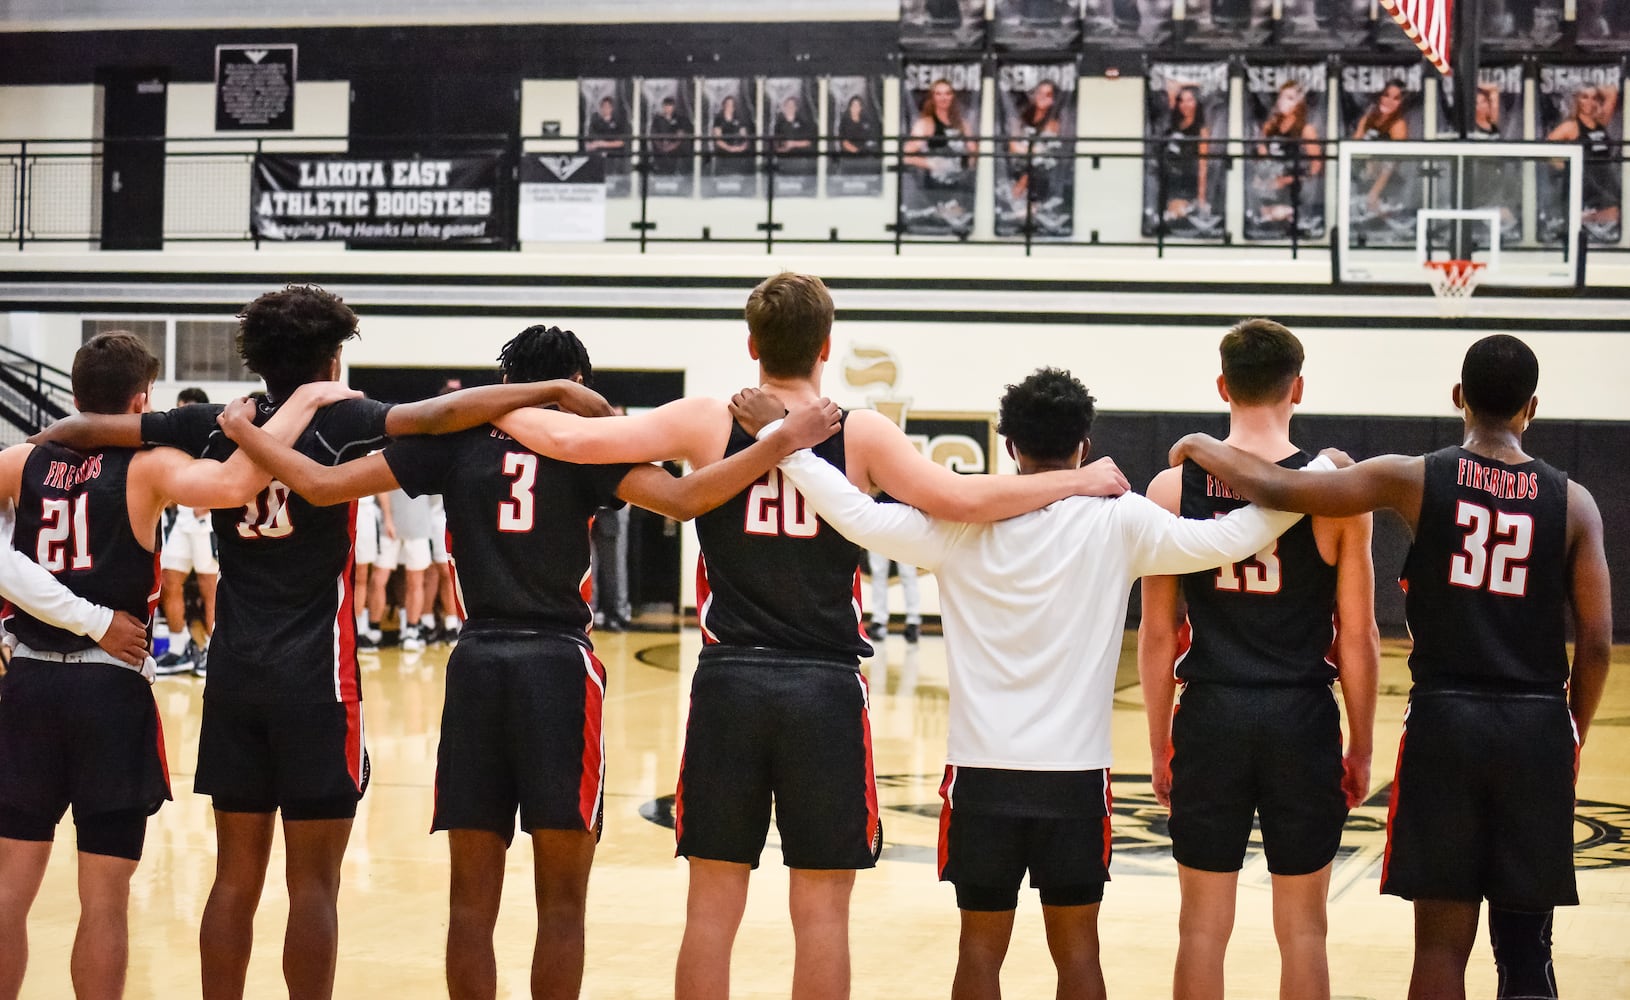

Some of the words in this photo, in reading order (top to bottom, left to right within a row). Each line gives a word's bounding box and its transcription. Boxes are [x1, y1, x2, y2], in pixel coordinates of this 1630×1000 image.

[298, 161, 386, 187] LAKOTA
[391, 161, 452, 187] EAST
[258, 191, 370, 216] ATHLETIC
[375, 191, 492, 216] BOOSTERS
[268, 222, 325, 239] eeping
[328, 222, 353, 237] The
[353, 222, 400, 237] Hawks
[418, 222, 442, 237] the
[497, 451, 539, 533] 3
[743, 465, 820, 539] 20
[1457, 457, 1538, 500] FIREBIRDS
[35, 491, 93, 574] 21
[1448, 499, 1535, 598] 32
